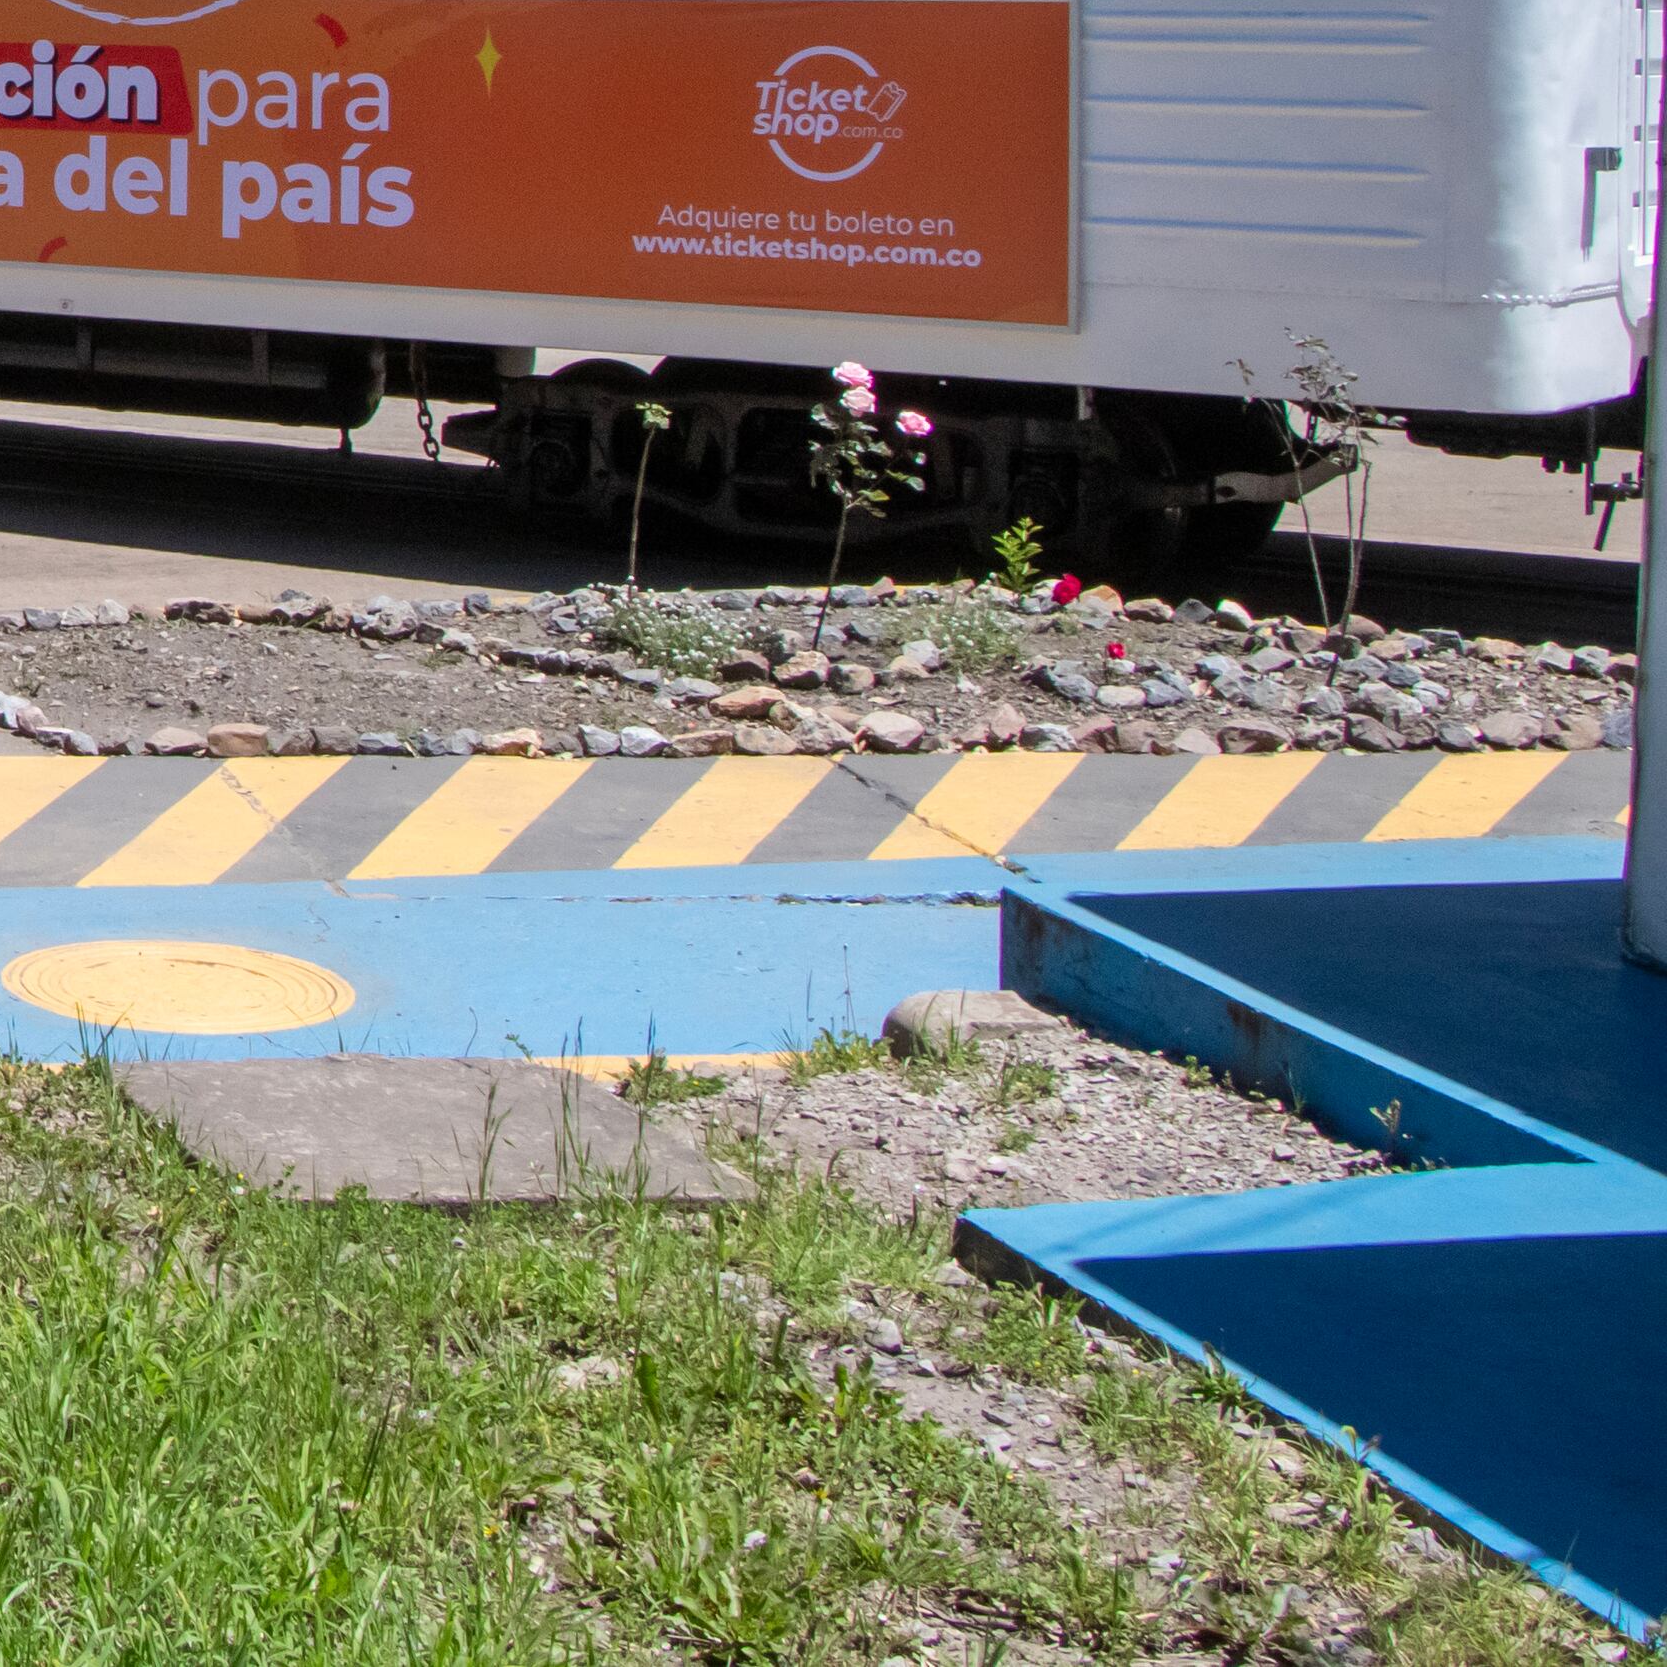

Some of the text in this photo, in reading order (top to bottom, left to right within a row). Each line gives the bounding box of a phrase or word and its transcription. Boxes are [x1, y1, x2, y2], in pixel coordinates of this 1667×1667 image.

[198, 67, 391, 146] para
[756, 79, 868, 112] Ticket
[752, 109, 840, 143] shop
[54, 135, 189, 217] del
[222, 143, 416, 239] país
[657, 204, 955, 236] Adquiere tu boleto en
[632, 232, 982, 267] www.ticketshop.com.co
